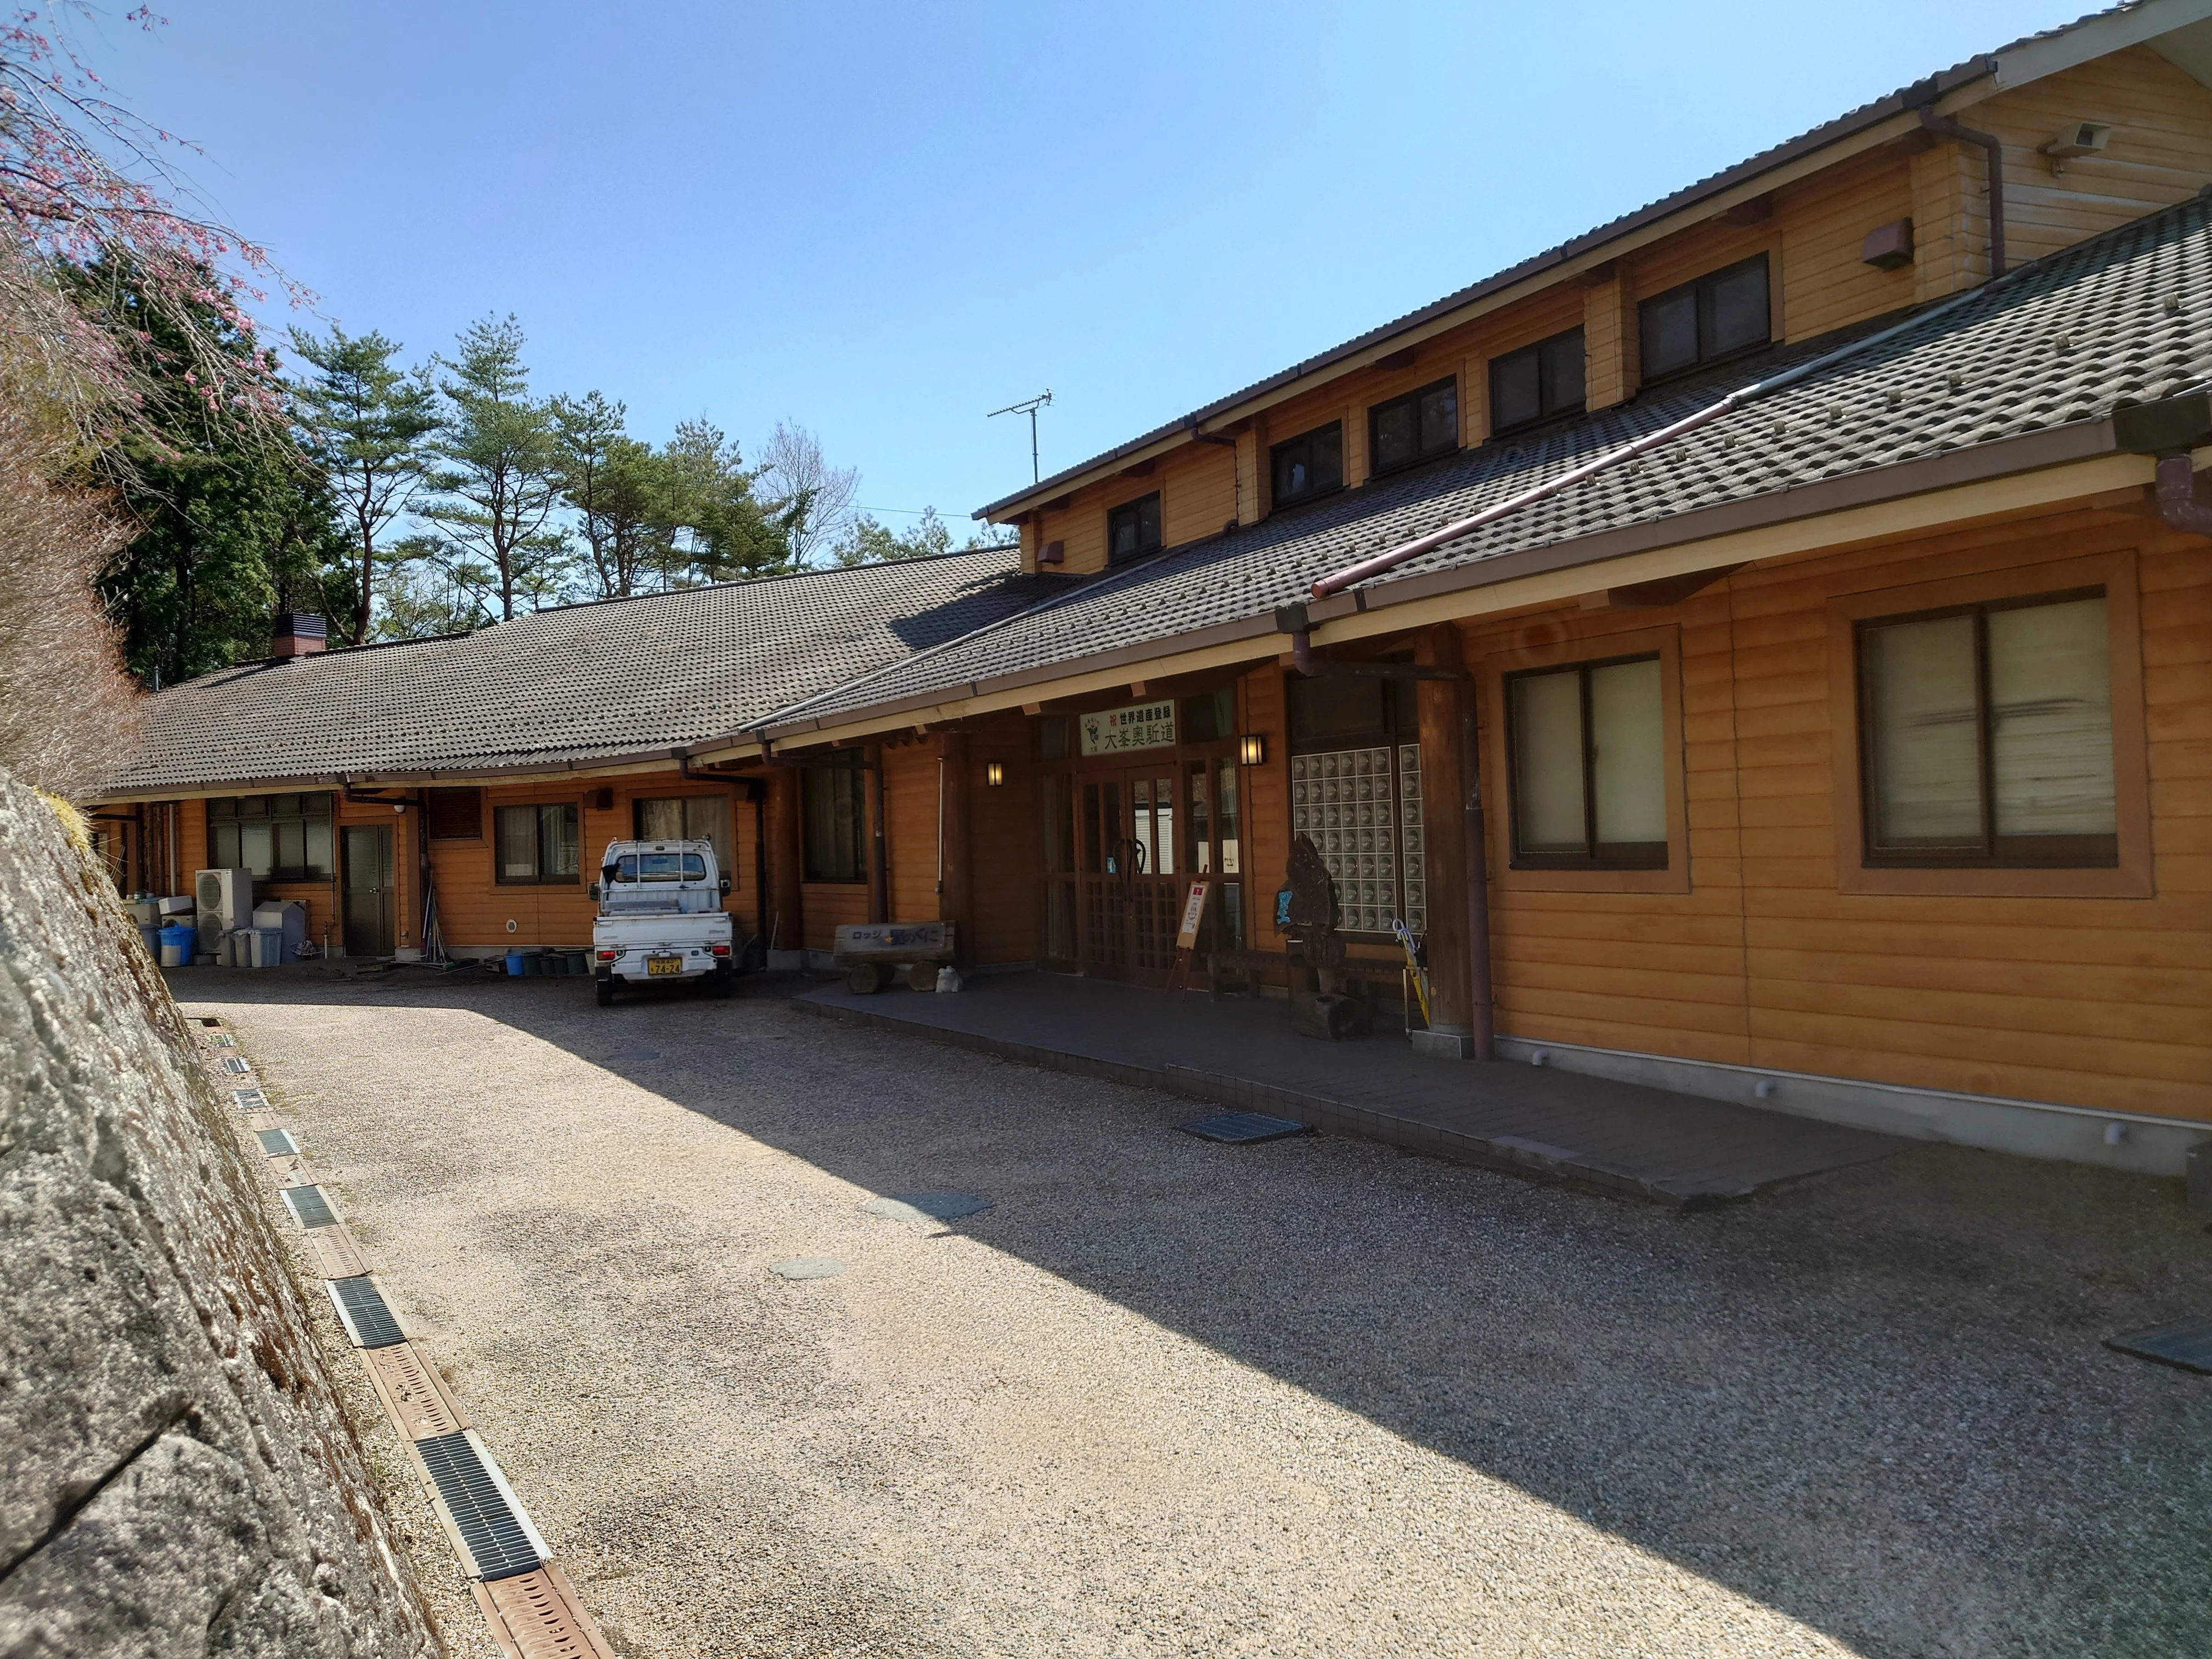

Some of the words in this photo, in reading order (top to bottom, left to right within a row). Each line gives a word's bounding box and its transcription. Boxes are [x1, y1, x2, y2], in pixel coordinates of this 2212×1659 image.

[1109, 714, 1116, 727] 祝
[1120, 705, 1171, 725] 世界遺産登録
[853, 929, 882, 940] ロッジ
[654, 964, 680, 973] 74-24
